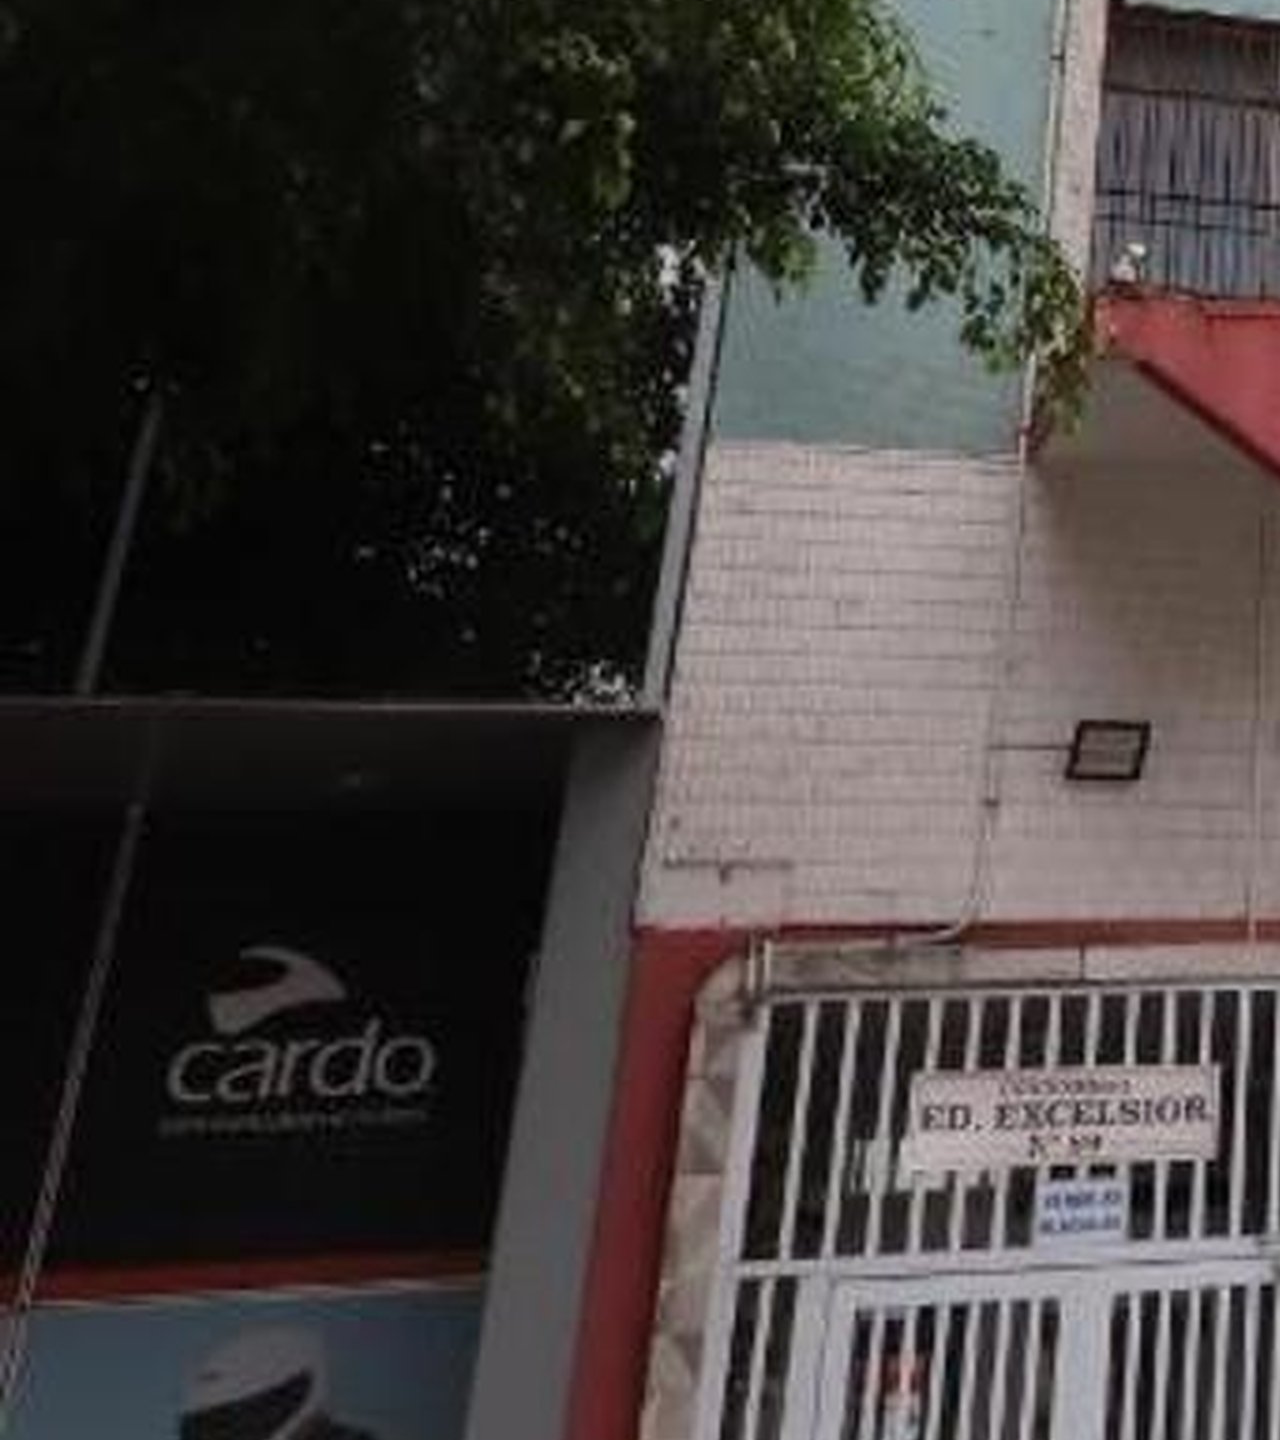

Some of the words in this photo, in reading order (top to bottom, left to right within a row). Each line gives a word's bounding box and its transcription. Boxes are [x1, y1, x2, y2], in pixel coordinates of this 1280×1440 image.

[167, 1017, 435, 1104] cardo
[920, 1103, 983, 1133] ED.
[994, 1093, 1213, 1131] EXCELSIOR
